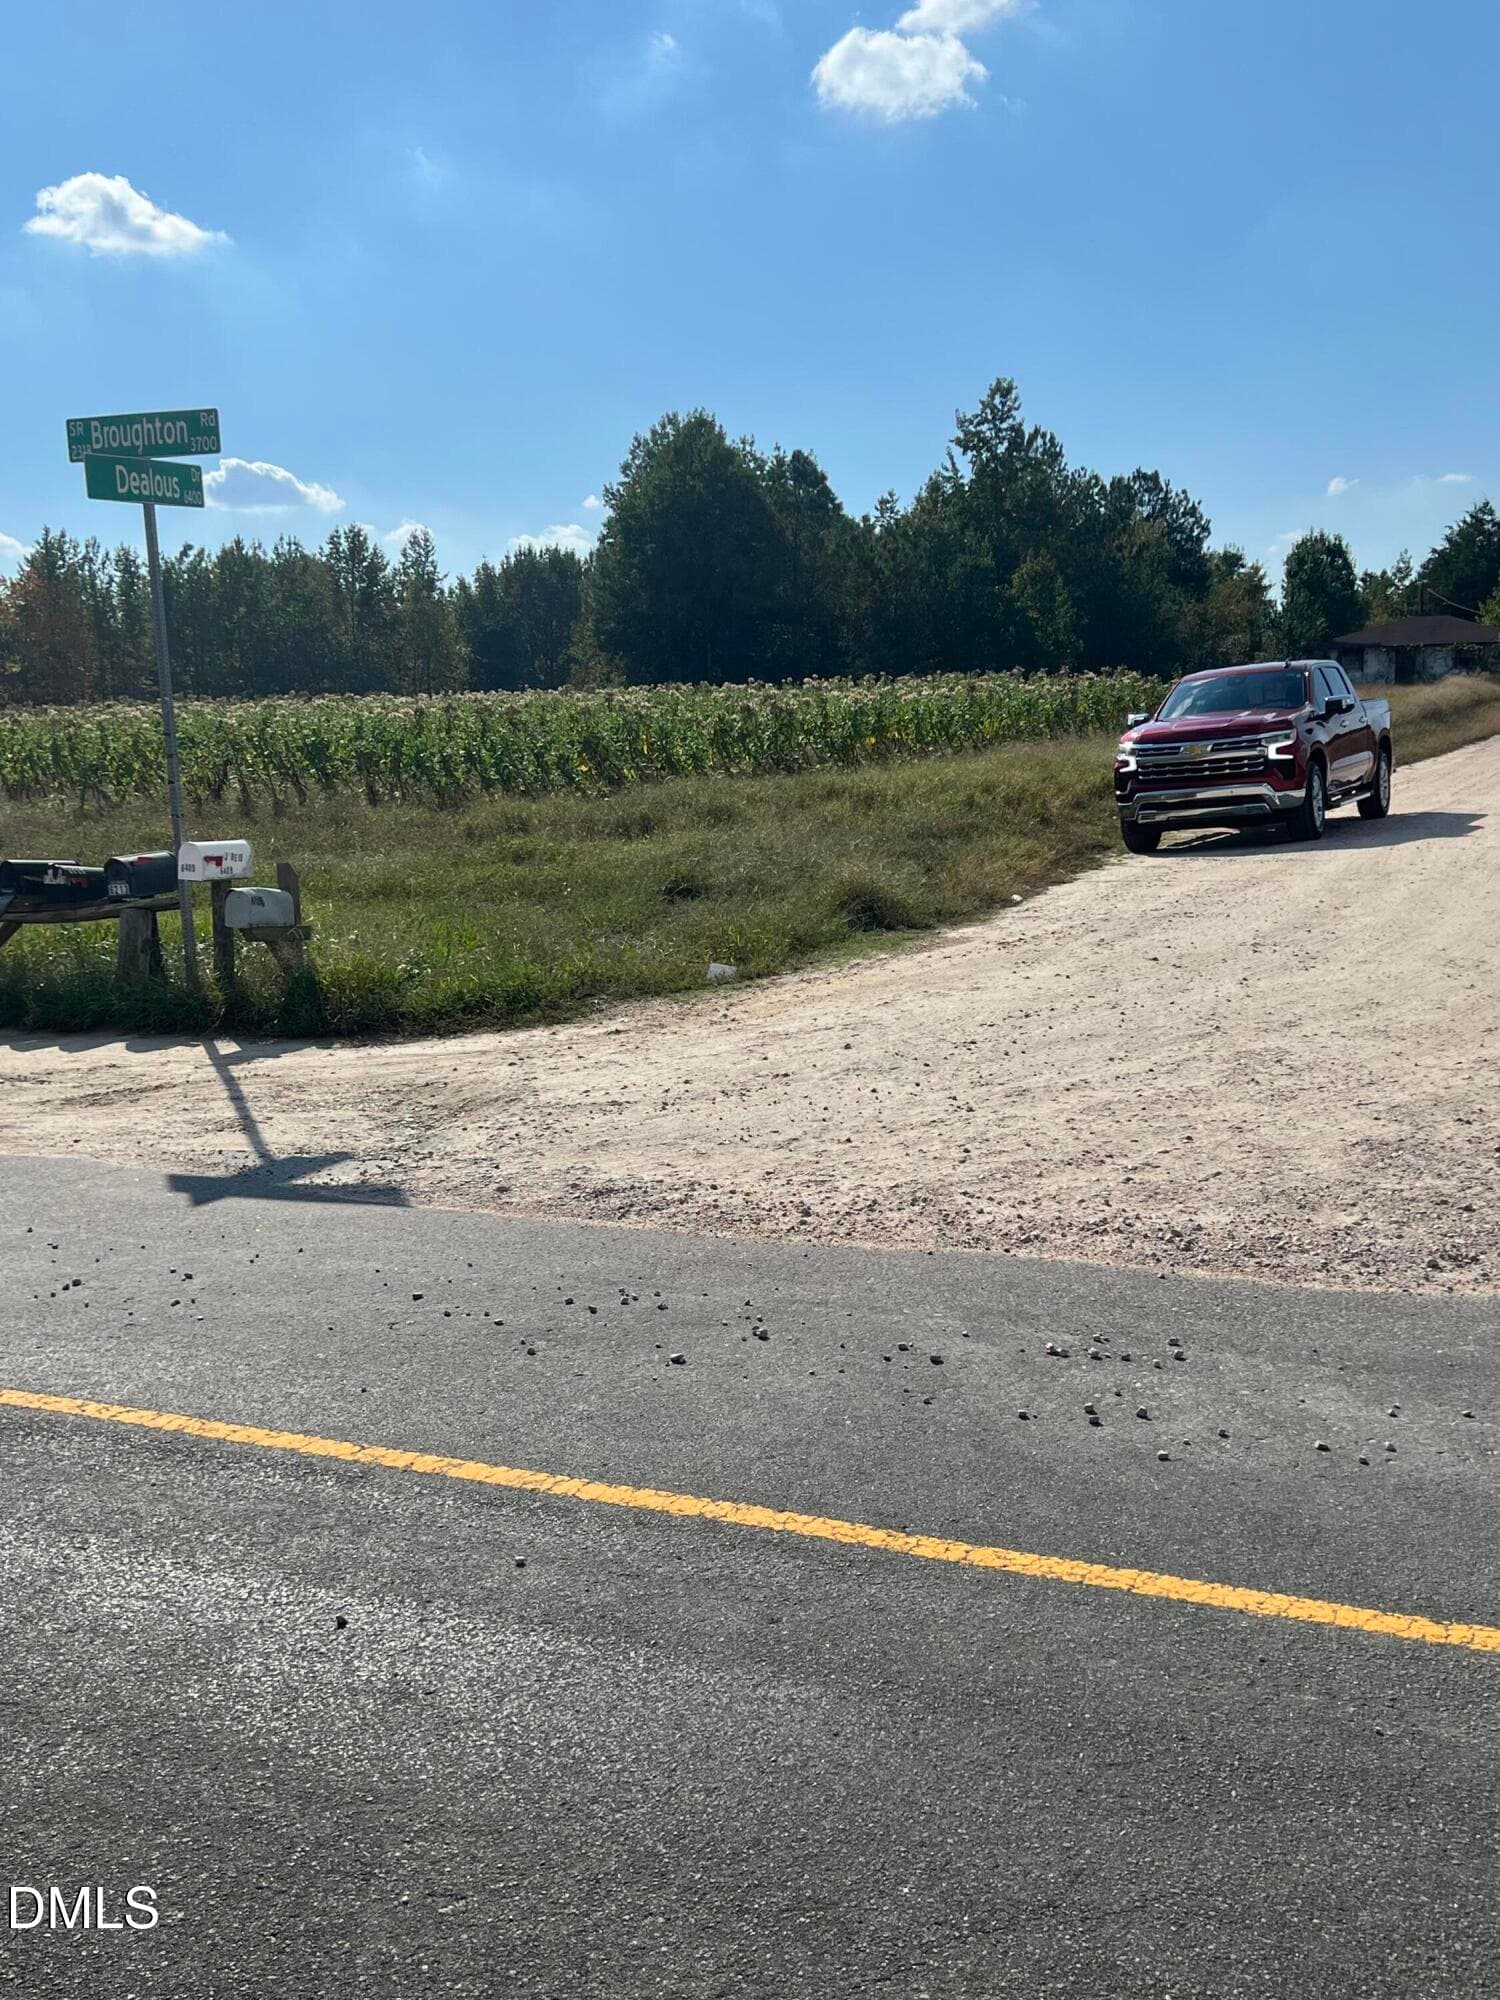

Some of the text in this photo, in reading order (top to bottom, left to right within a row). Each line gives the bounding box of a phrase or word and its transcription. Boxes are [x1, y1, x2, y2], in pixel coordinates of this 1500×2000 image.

[69, 412, 216, 454] SR Broughton Rd
[190, 435, 217, 452] 3700
[115, 464, 180, 498] Dealous
